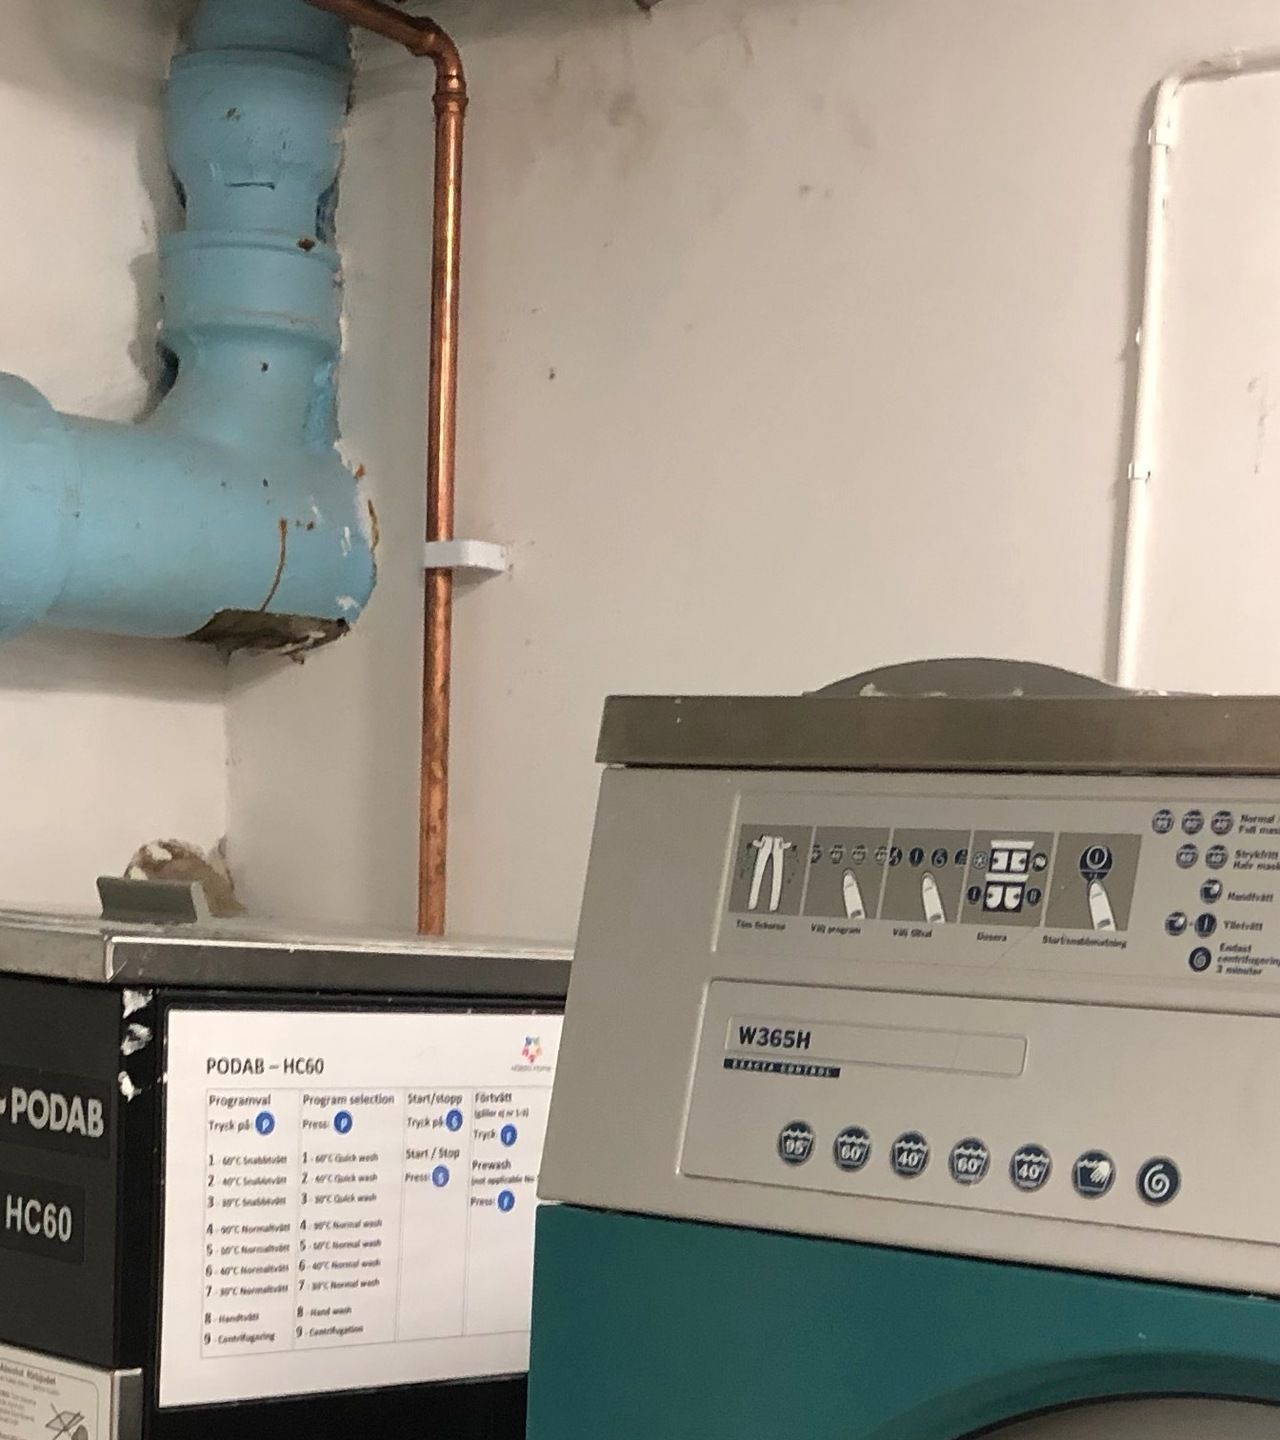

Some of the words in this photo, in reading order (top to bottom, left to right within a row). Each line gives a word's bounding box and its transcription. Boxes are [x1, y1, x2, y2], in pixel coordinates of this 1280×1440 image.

[1240, 814, 1275, 823] Normal
[828, 925, 861, 936] program
[739, 1025, 812, 1050] W365H
[206, 1057, 265, 1075] PODAB
[283, 1057, 325, 1075] HC60
[208, 1094, 272, 1110] Programval
[303, 1093, 348, 1109] Program
[350, 1094, 395, 1106] selection
[407, 1091, 463, 1106] Start/stopp
[474, 1091, 513, 1104] Förtvätt
[11, 1086, 105, 1138] PODAB
[208, 1119, 235, 1133] Tryck
[407, 1116, 430, 1129] Tryck
[209, 1154, 214, 1166] 1
[302, 1151, 307, 1164] 1
[334, 1153, 356, 1163] Quick
[358, 1152, 379, 1162] wash
[405, 1148, 429, 1160] Start
[438, 1147, 460, 1160] Stop
[471, 1158, 512, 1171] Prewash
[208, 1174, 215, 1187] 2
[302, 1171, 308, 1184] 2
[334, 1173, 356, 1183] Quick
[358, 1172, 378, 1182] wash
[207, 1195, 214, 1208] 3
[301, 1192, 307, 1205] 3
[333, 1193, 355, 1204] Quick
[357, 1193, 377, 1202] wash
[5, 1194, 72, 1243] HC60
[300, 1219, 306, 1230] 4
[332, 1219, 361, 1230] Normal
[362, 1218, 383, 1228] wash
[206, 1223, 213, 1235] 4
[206, 1243, 213, 1256] 5
[299, 1239, 306, 1251] 5
[332, 1239, 361, 1249] Normal
[362, 1238, 382, 1248] wash
[205, 1264, 213, 1277] 6
[298, 1259, 305, 1272] 6
[331, 1259, 360, 1269] Normal
[361, 1258, 381, 1268] wash
[206, 1285, 212, 1297] 7
[298, 1279, 305, 1291] 7
[330, 1280, 359, 1290] Normal
[360, 1278, 380, 1287] wash
[205, 1312, 211, 1324] 8
[296, 1305, 304, 1318] 8
[310, 1306, 331, 1317] Hand
[332, 1306, 352, 1316] wash
[295, 1325, 303, 1338] 9
[204, 1332, 211, 1345] 9
